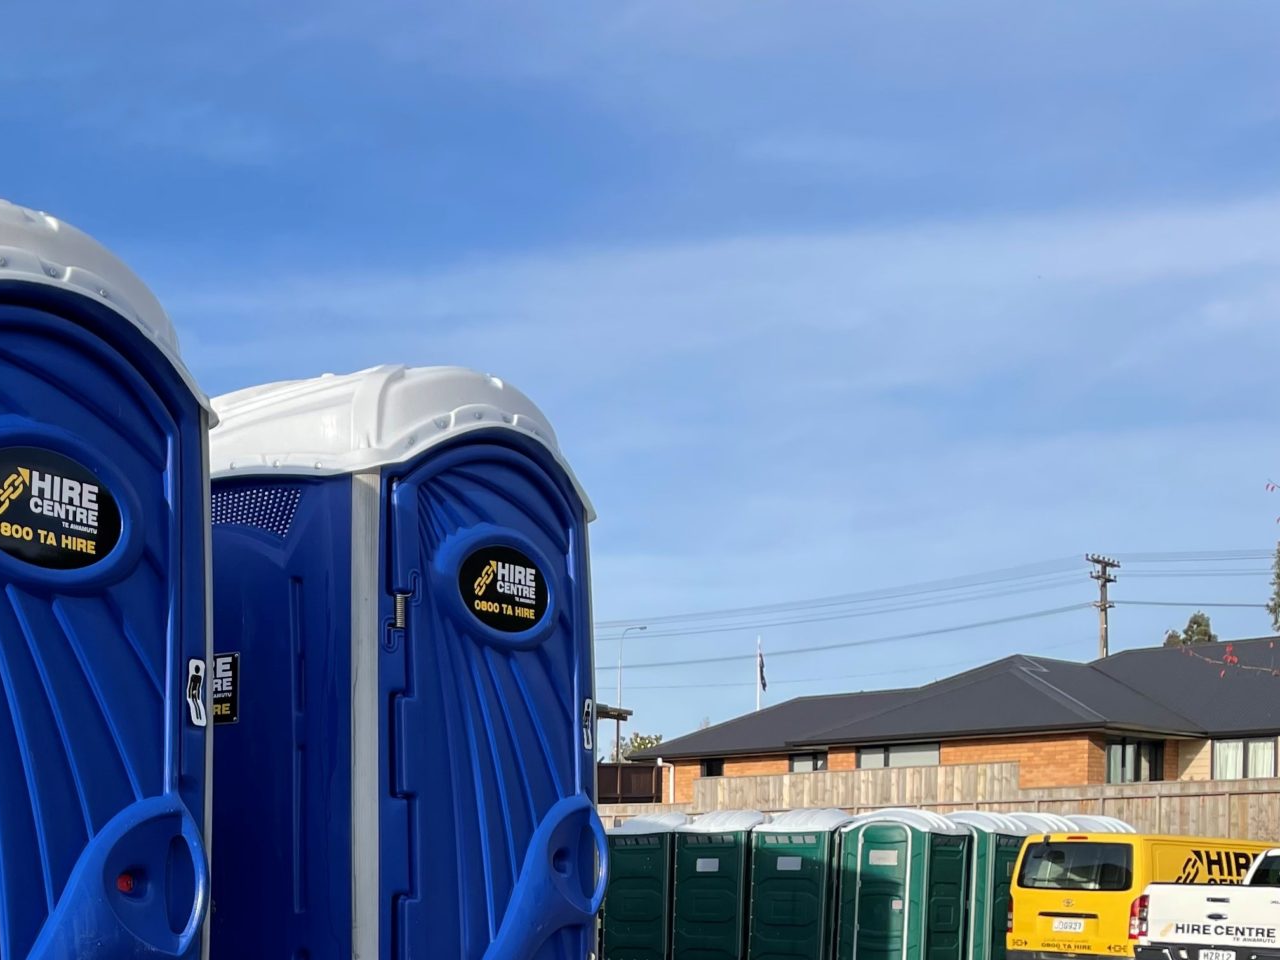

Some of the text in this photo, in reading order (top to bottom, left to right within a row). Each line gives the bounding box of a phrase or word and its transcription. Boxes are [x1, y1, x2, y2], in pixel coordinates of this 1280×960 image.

[31, 470, 99, 511] HIRE
[29, 497, 99, 526] CENTRE
[37, 529, 57, 546] TA
[61, 535, 96, 555] HIRE
[497, 561, 536, 587] HIRE
[496, 581, 536, 599] CENTRE
[474, 600, 499, 613] 0800
[501, 604, 513, 616] TA
[515, 606, 535, 620] HIRE
[1204, 850, 1261, 877] HIR
[1175, 923, 1276, 938] HIRE CENTRE
